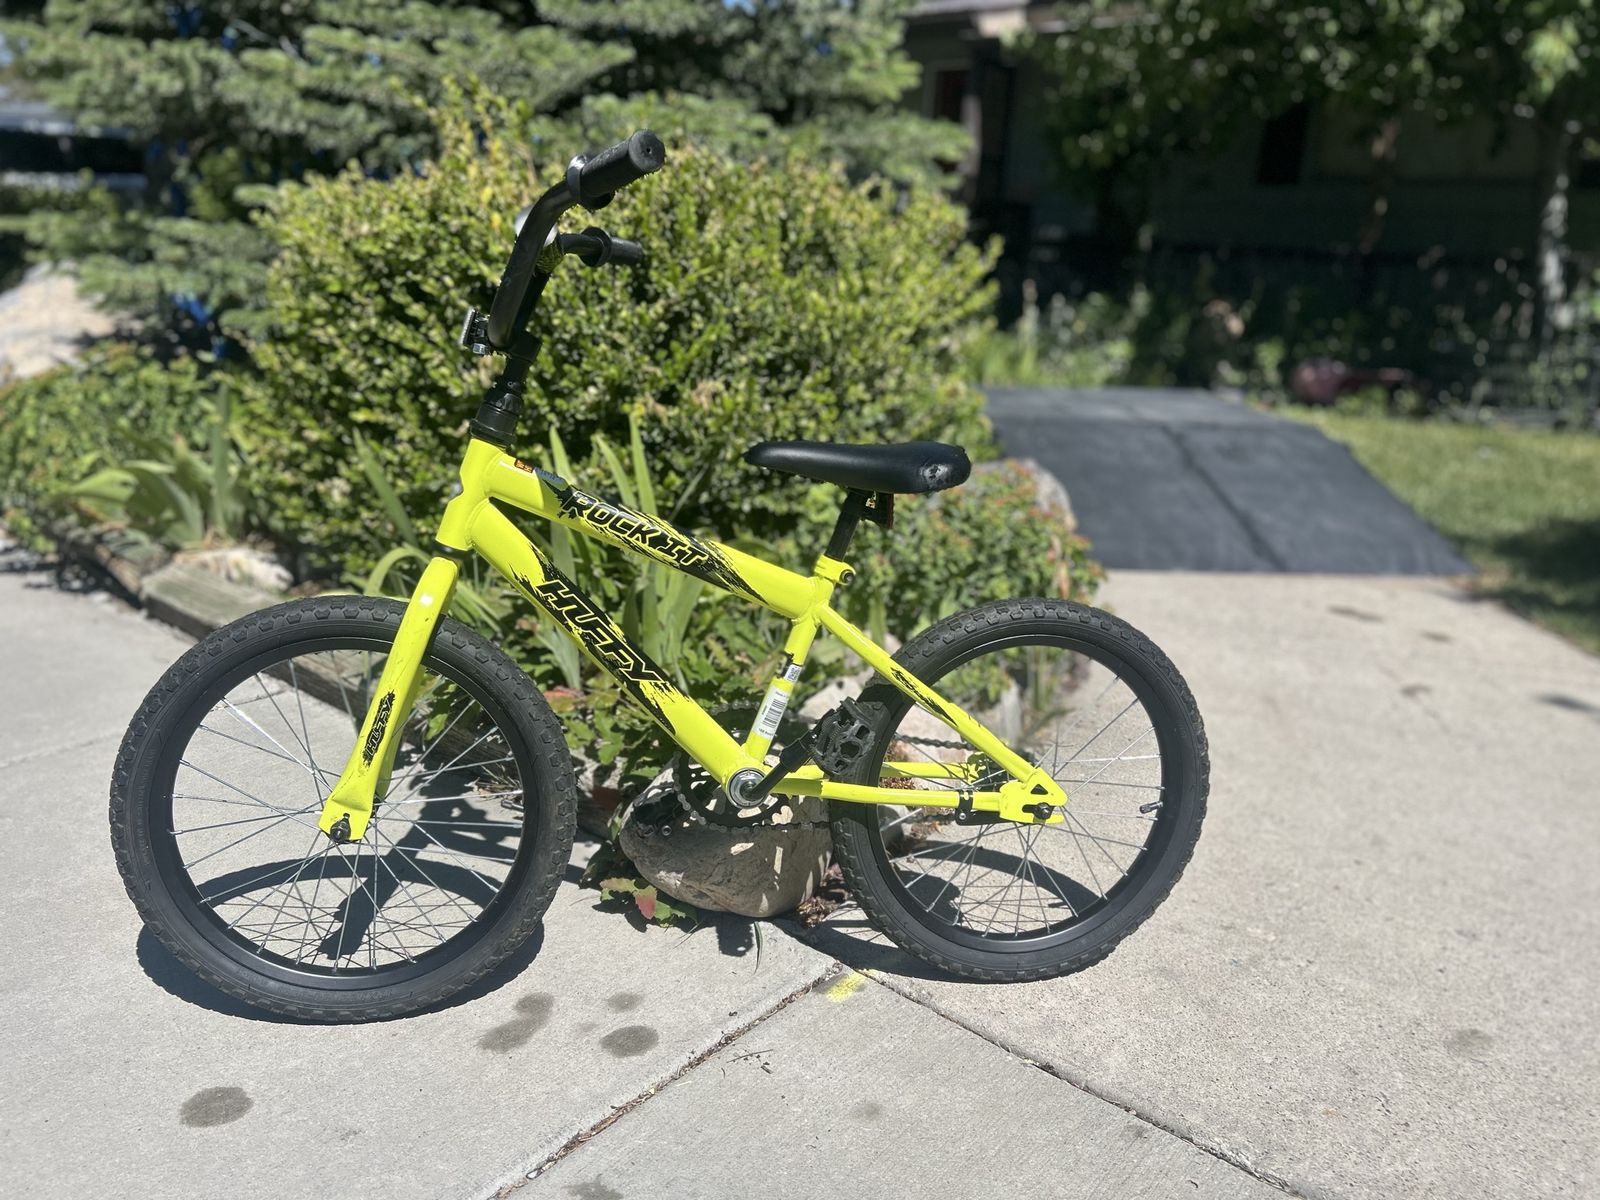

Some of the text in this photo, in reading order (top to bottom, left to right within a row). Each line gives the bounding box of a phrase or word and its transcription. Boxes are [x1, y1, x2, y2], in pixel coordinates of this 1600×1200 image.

[562, 490, 709, 566] ROCK IT
[535, 579, 665, 683] HUFFY
[365, 695, 392, 756] HUFFY
